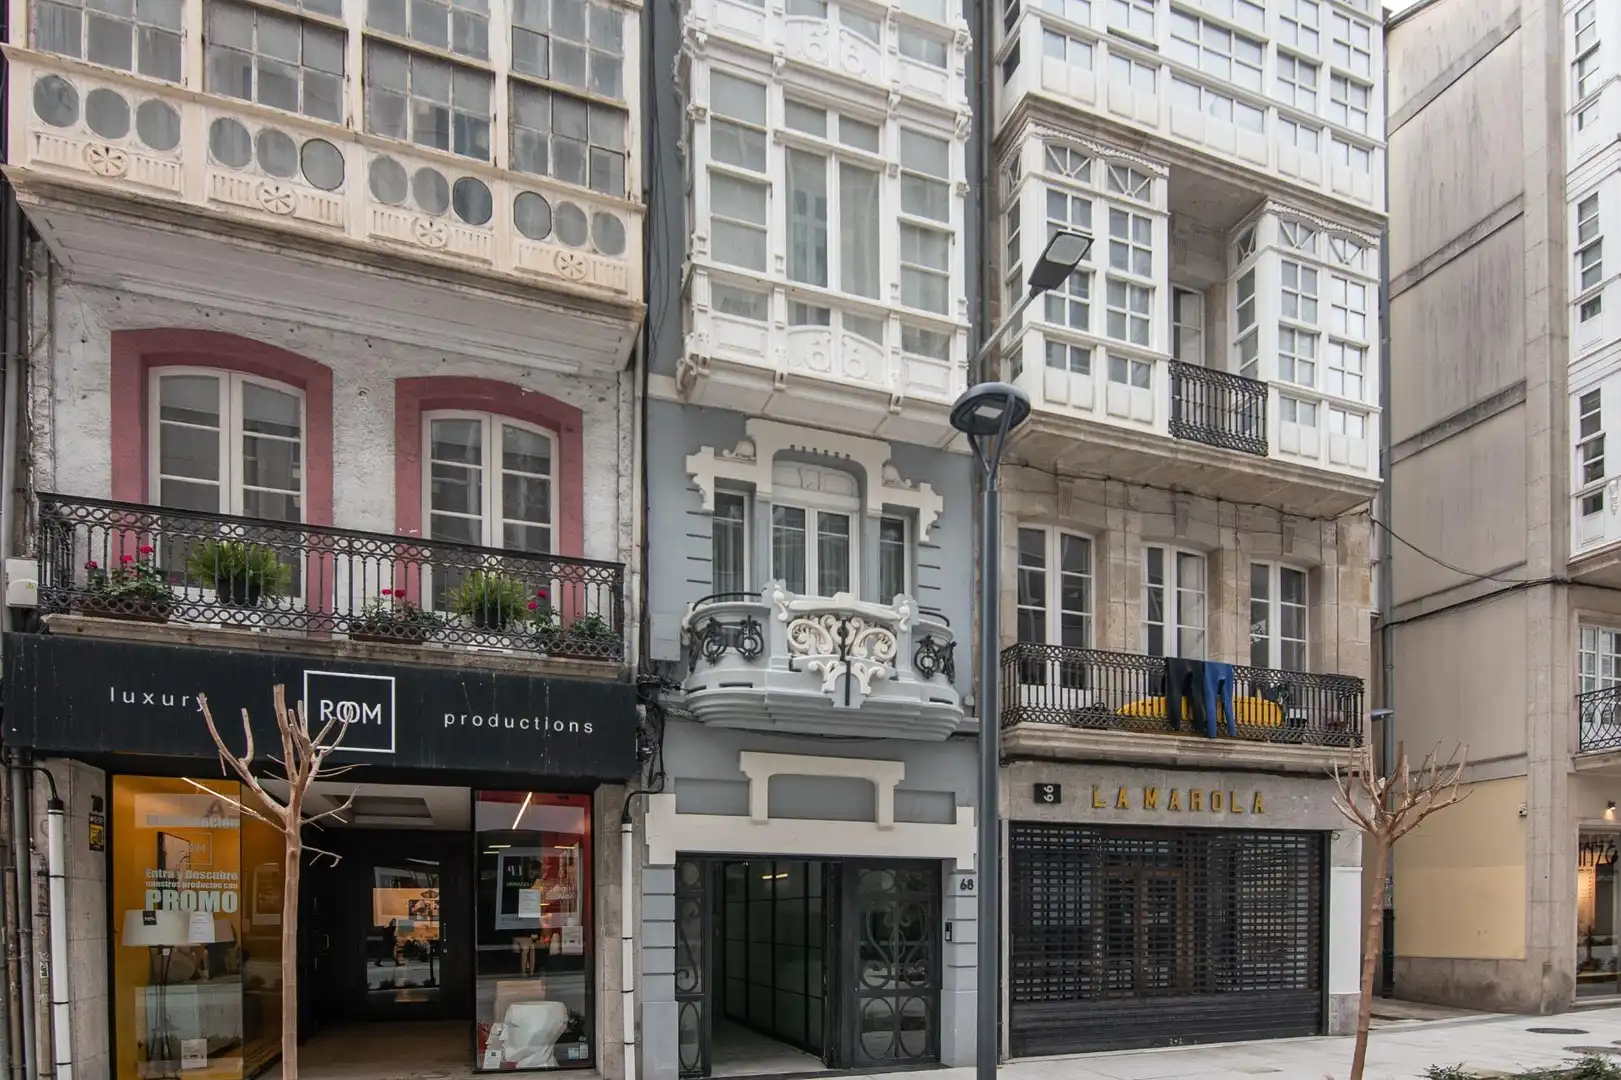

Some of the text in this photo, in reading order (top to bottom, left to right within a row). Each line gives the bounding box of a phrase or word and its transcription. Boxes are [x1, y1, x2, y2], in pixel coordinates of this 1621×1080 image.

[110, 686, 208, 712] luxury
[320, 699, 382, 725] ROOM
[444, 713, 594, 734] productions
[1092, 784, 1265, 814] LA MAROLA
[145, 868, 175, 879] Entra
[960, 878, 974, 891] 68
[145, 889, 238, 914] PROMO
